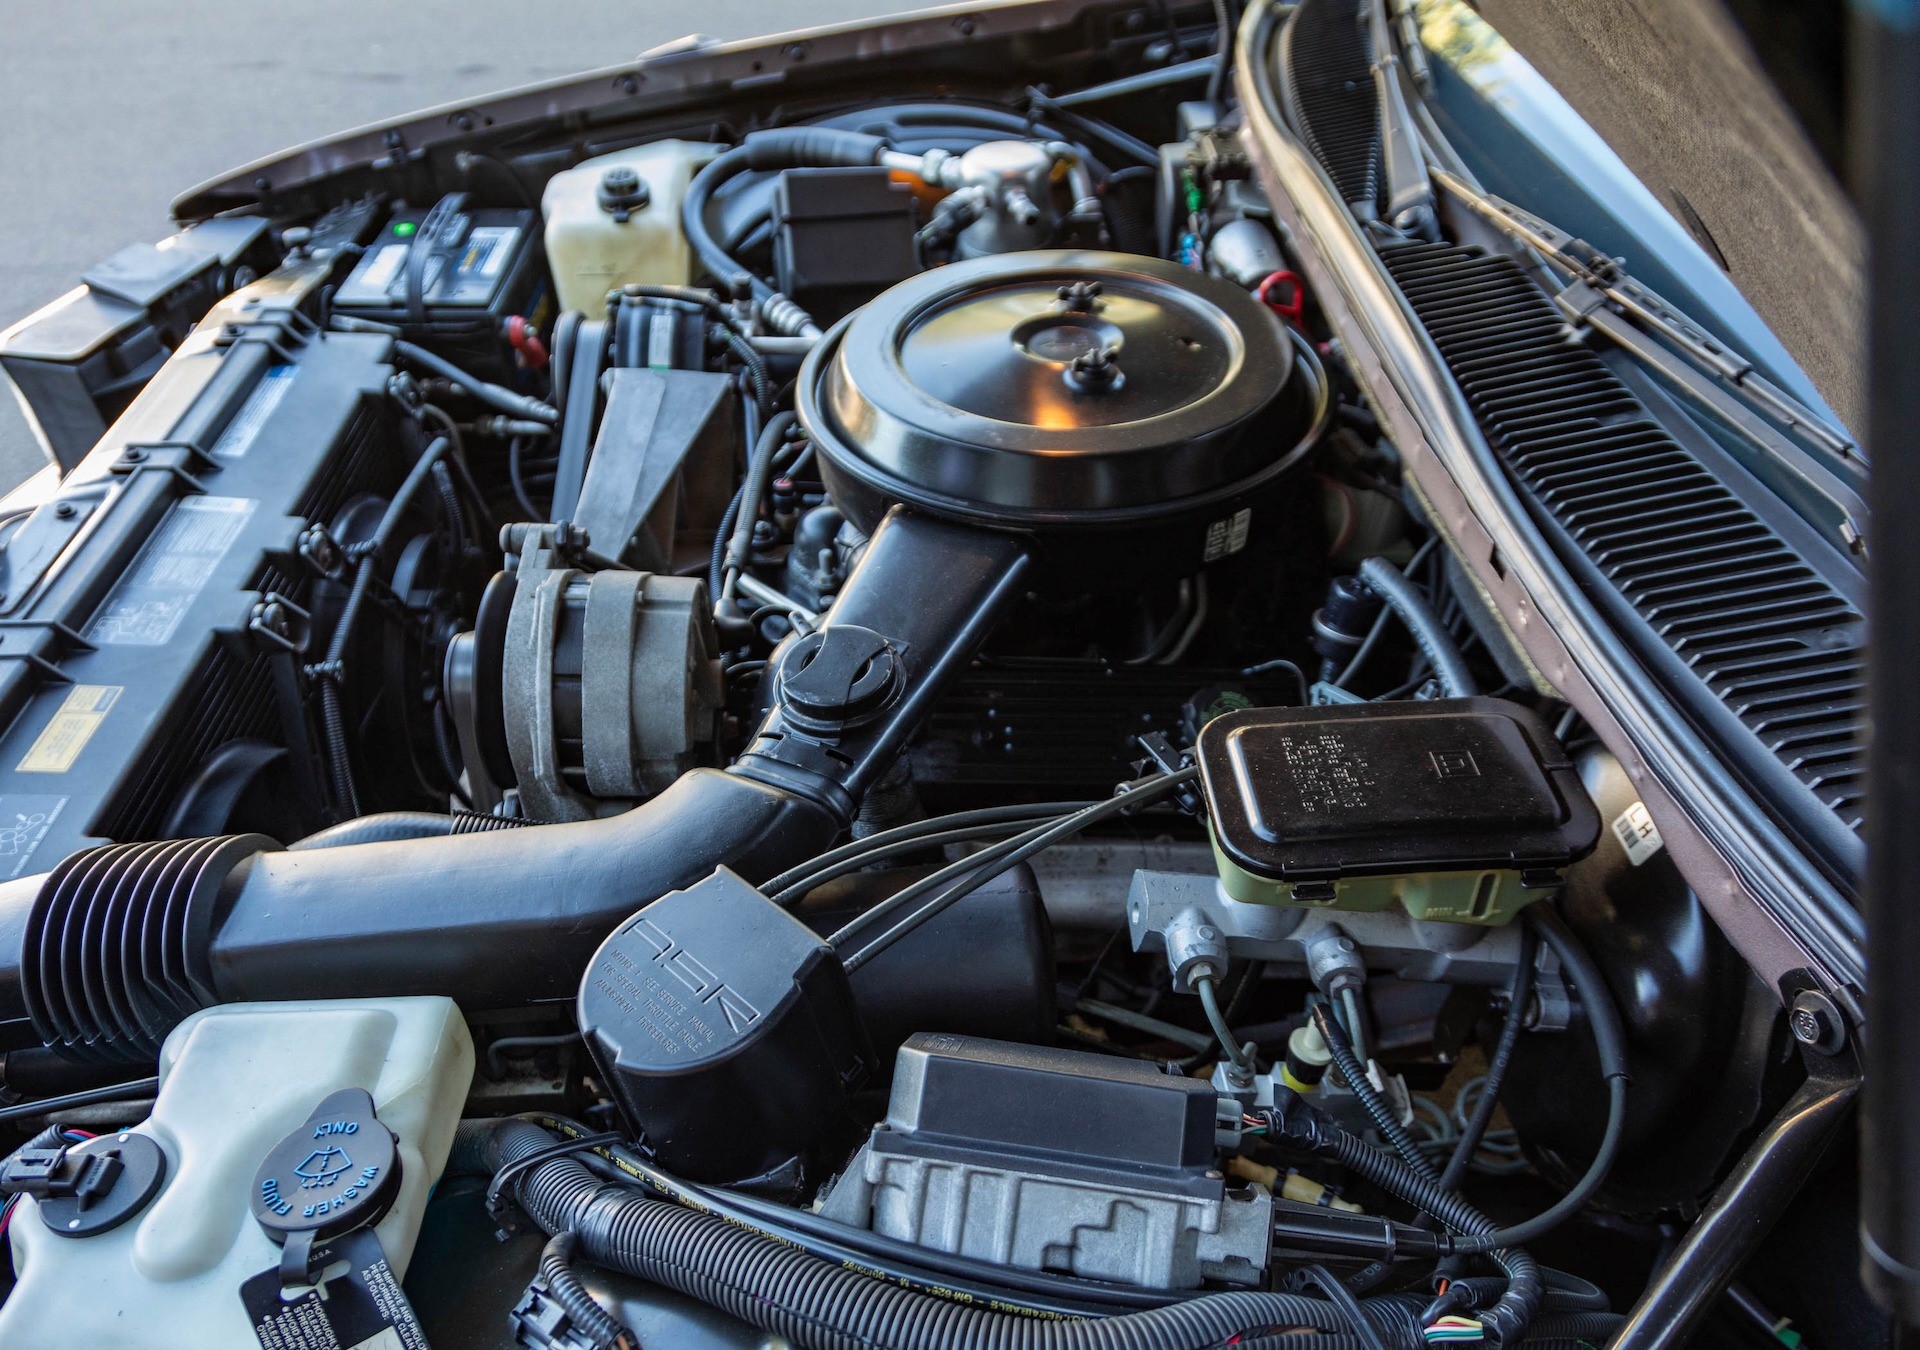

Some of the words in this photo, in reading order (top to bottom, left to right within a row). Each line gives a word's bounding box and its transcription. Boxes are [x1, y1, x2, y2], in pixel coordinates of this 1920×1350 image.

[1426, 907, 1454, 917] MIN
[600, 961, 614, 976] FOR
[614, 974, 643, 1001] SPECIAL
[642, 998, 680, 1031] THROTTLE
[676, 1024, 703, 1053] CABLE
[610, 950, 637, 972] NOTICE
[643, 976, 660, 993] SEE
[656, 989, 688, 1016] SERVICE
[687, 1016, 716, 1043] MANUAL
[594, 979, 637, 1015] ADJUSTMENT
[636, 1016, 680, 1055] PROCEDURES
[313, 1121, 359, 1139] ONLY
[262, 1178, 293, 1216] FLUID
[303, 1165, 379, 1217] WASHER
[679, 1194, 710, 1214] CAUTION
[361, 1269, 372, 1281] AS
[367, 1280, 390, 1320] FOLLOWS:
[377, 1259, 386, 1271] TO
[382, 1270, 404, 1306] IMPROVE
[399, 1306, 412, 1322] AND
[954, 1292, 973, 1303] GM
[265, 1320, 284, 1348] CLEAN
[275, 1314, 297, 1350] WASHER
[283, 1312, 301, 1336] AVOID
[293, 1306, 318, 1349] STRENGTH
[305, 1309, 323, 1337] CLEAN
[311, 1298, 341, 1350] THOROUGHLY
[398, 1322, 415, 1350] CLEAN
